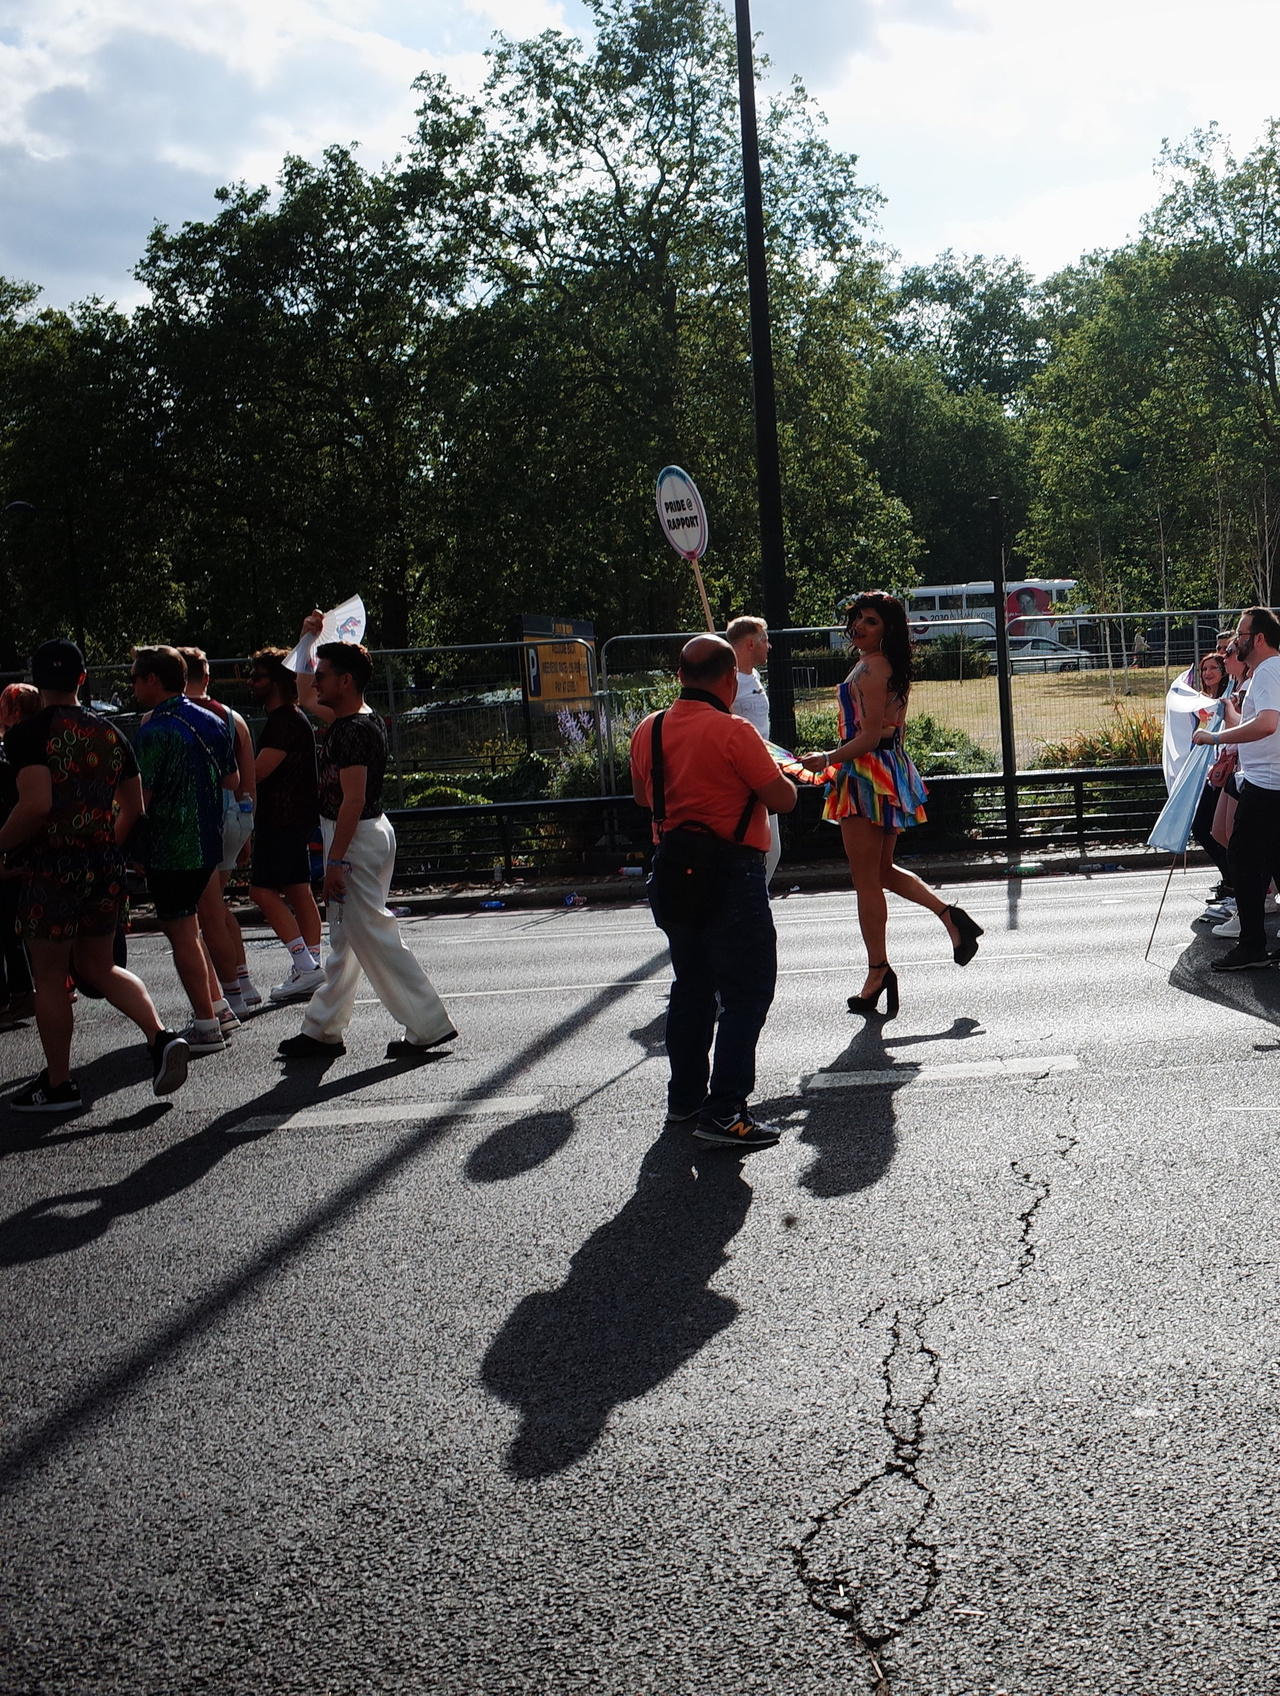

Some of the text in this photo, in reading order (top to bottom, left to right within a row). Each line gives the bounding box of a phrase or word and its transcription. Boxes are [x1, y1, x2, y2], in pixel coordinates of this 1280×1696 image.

[664, 499, 693, 513] PRIDE @
[667, 516, 699, 530] RAPPORT
[930, 613, 949, 622] 2030
[976, 611, 995, 620] KORE
